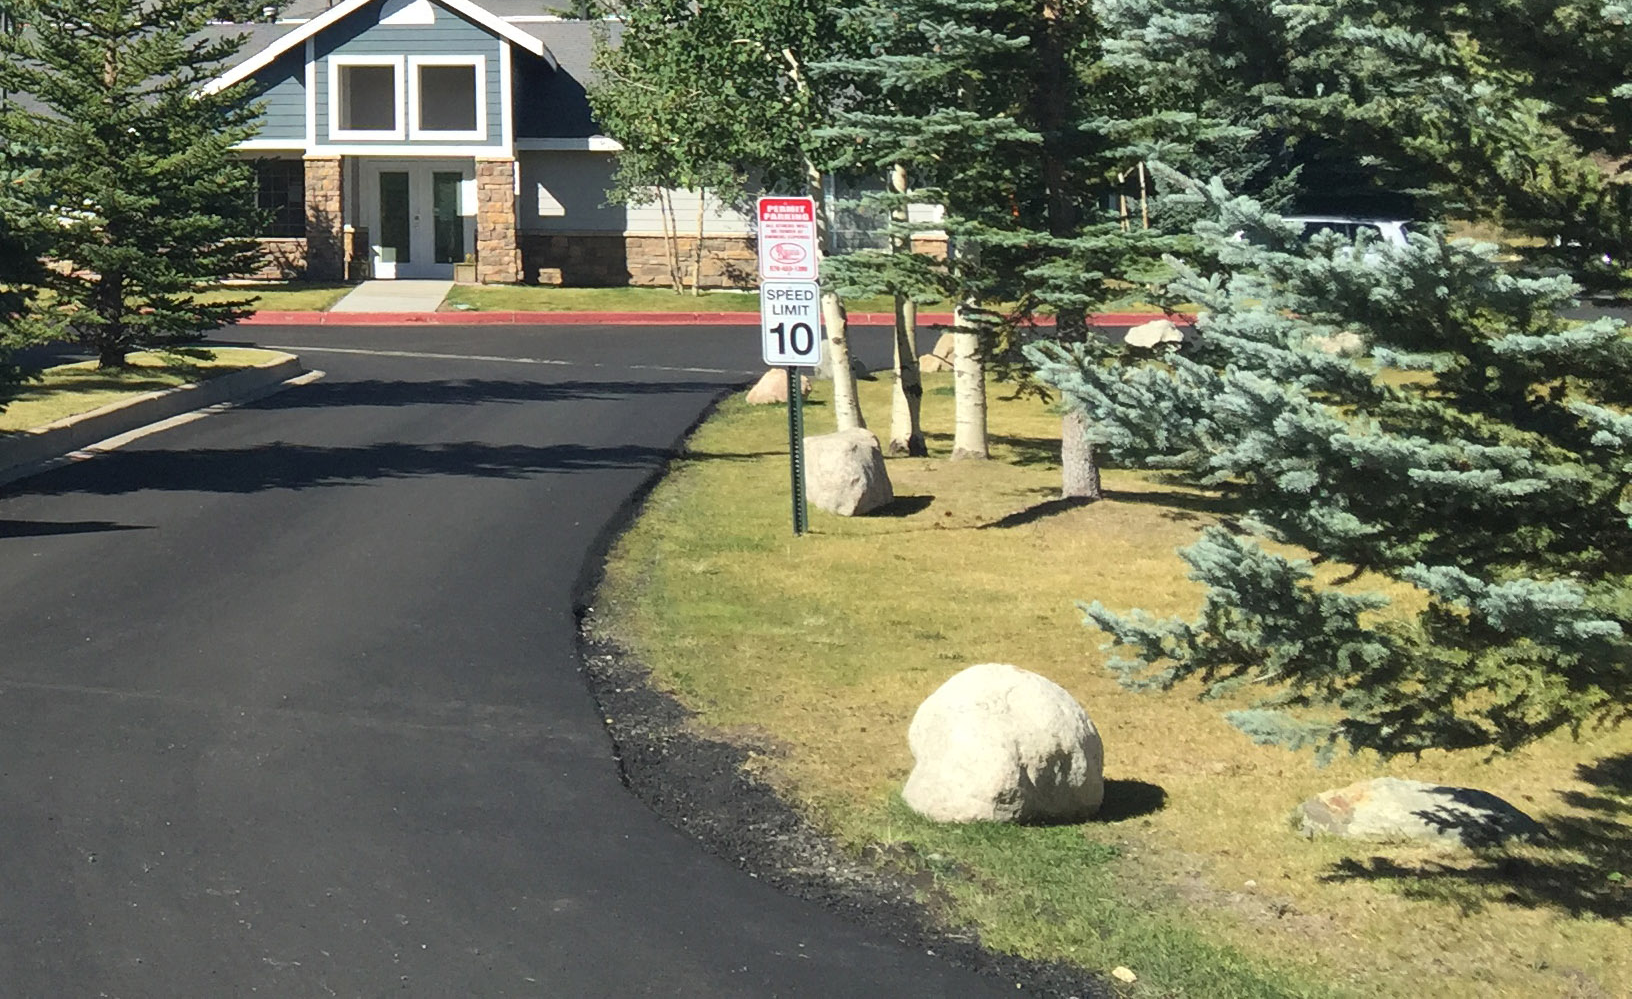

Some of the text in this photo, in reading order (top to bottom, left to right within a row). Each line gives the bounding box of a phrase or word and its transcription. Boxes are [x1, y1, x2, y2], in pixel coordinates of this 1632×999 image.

[766, 205, 806, 213] PERMIT
[763, 212, 810, 221] PARKING
[767, 289, 814, 301] SPEED
[772, 305, 810, 316] LIMIT
[770, 322, 814, 356] 10
